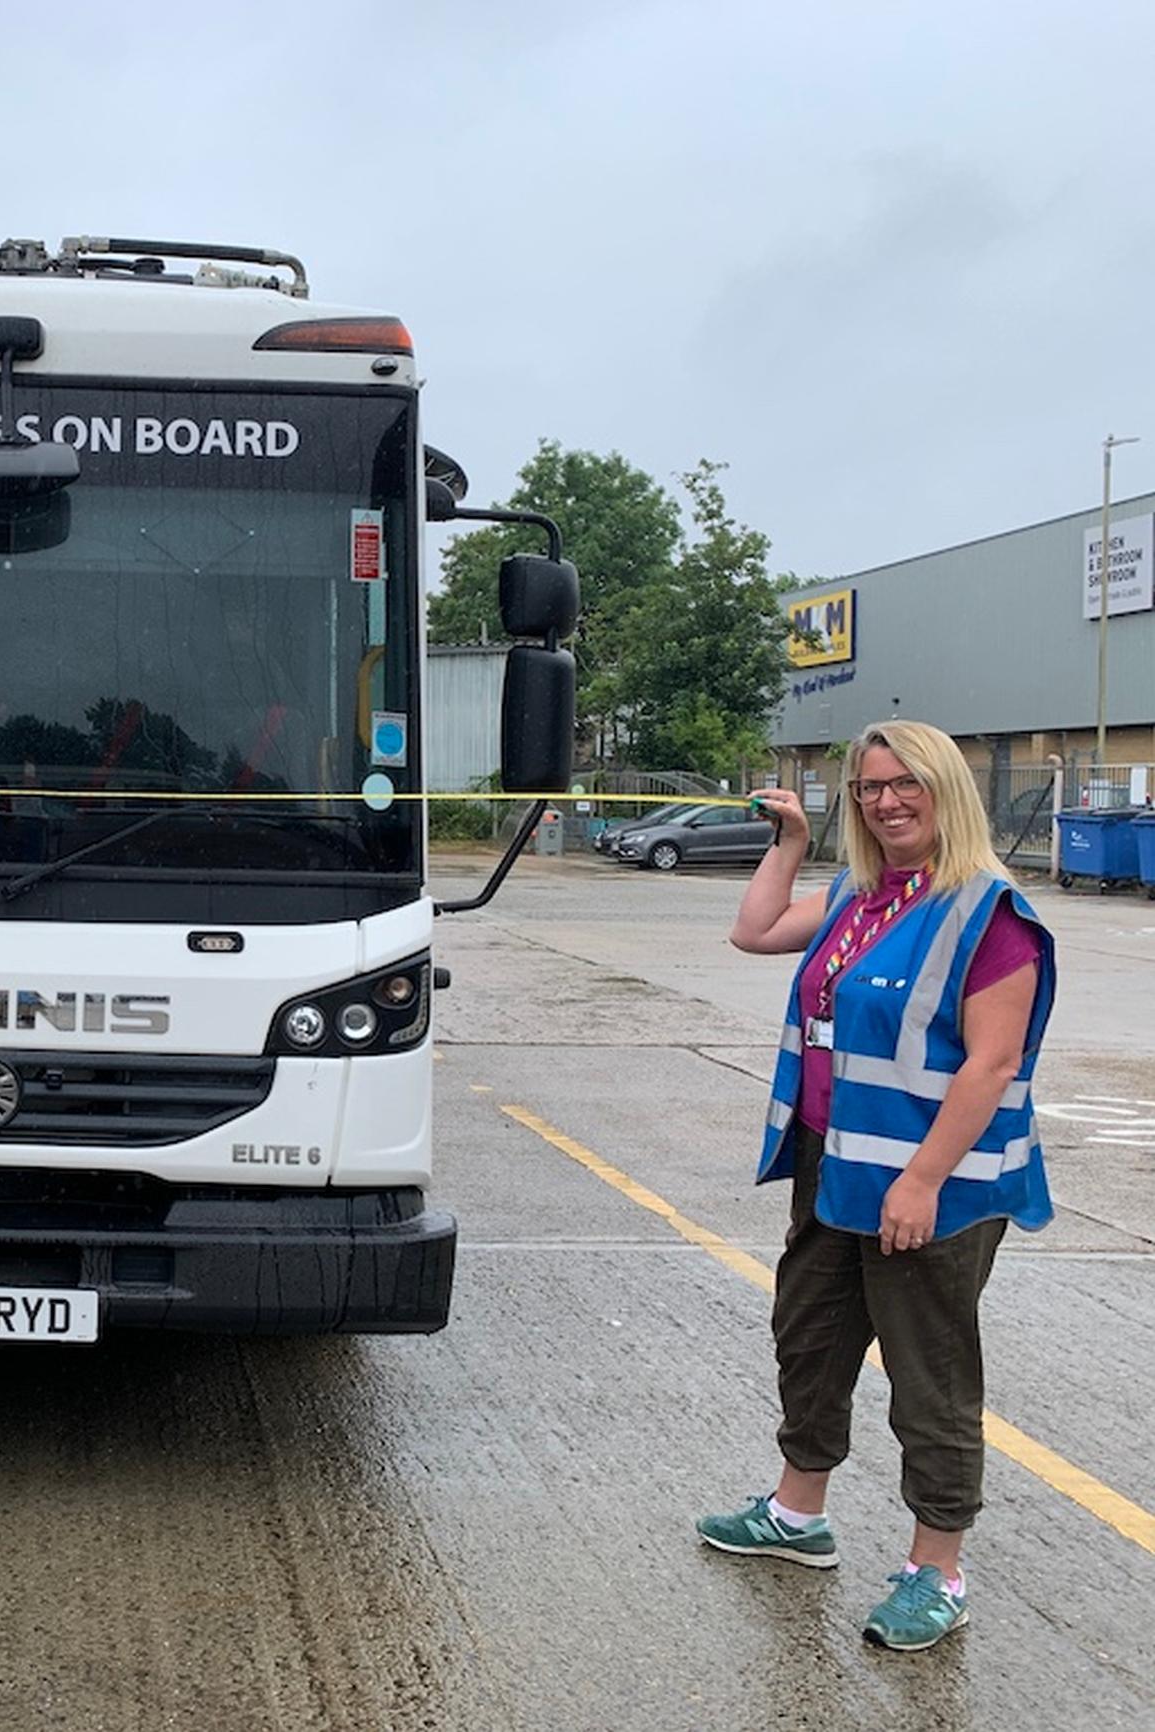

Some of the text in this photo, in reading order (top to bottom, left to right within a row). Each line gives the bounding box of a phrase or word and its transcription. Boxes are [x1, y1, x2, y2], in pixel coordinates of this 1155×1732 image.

[52, 415, 122, 452] ON
[136, 417, 299, 457] BOARD
[1089, 536, 1124, 555] KITHEN
[1097, 548, 1143, 570] BTHROOM
[1088, 567, 1136, 588] SHWROOM
[232, 1143, 321, 1165] ELITE 6
